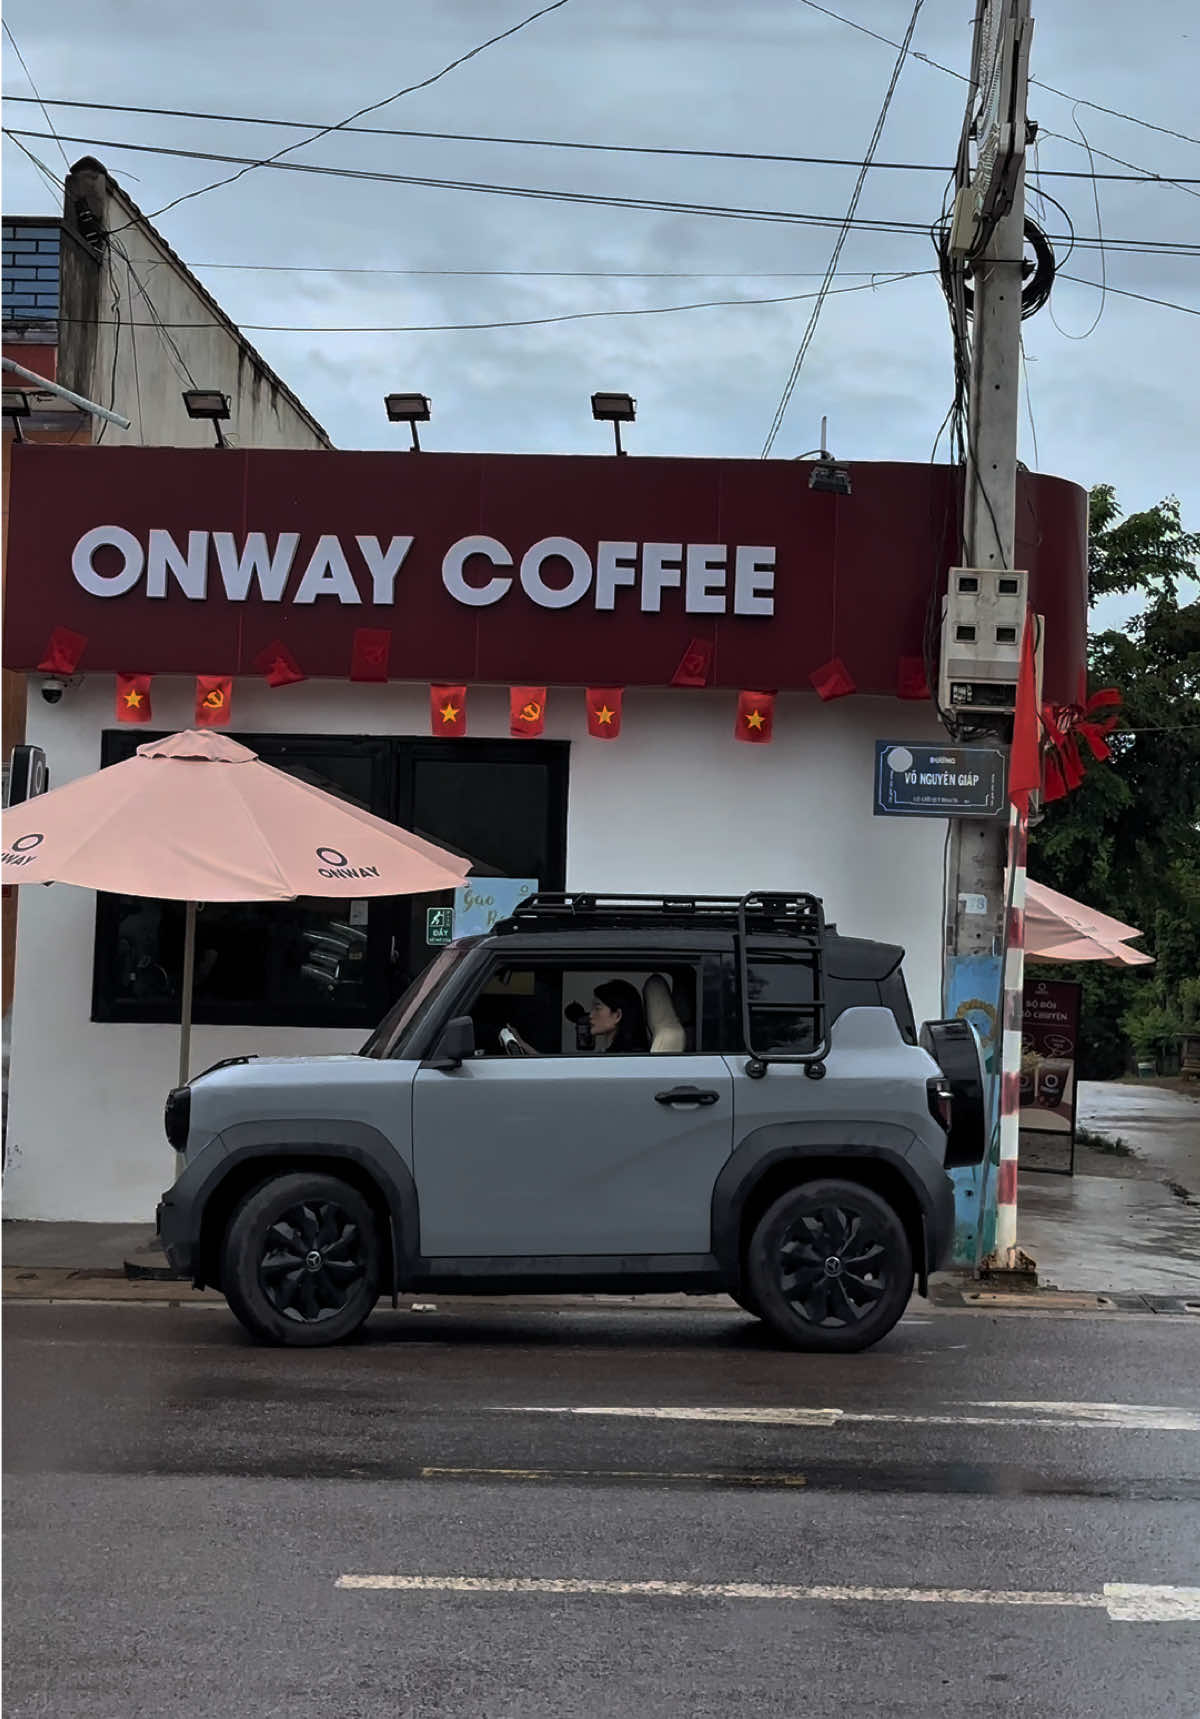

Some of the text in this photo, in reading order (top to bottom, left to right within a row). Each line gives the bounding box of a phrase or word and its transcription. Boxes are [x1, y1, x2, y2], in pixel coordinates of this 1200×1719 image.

[72, 525, 777, 617] ONWAY COFFEE
[919, 770, 956, 786] NGUYÊN
[957, 771, 980, 787] GIÁP
[2, 852, 38, 866] WAY
[318, 866, 380, 878] ONWAY
